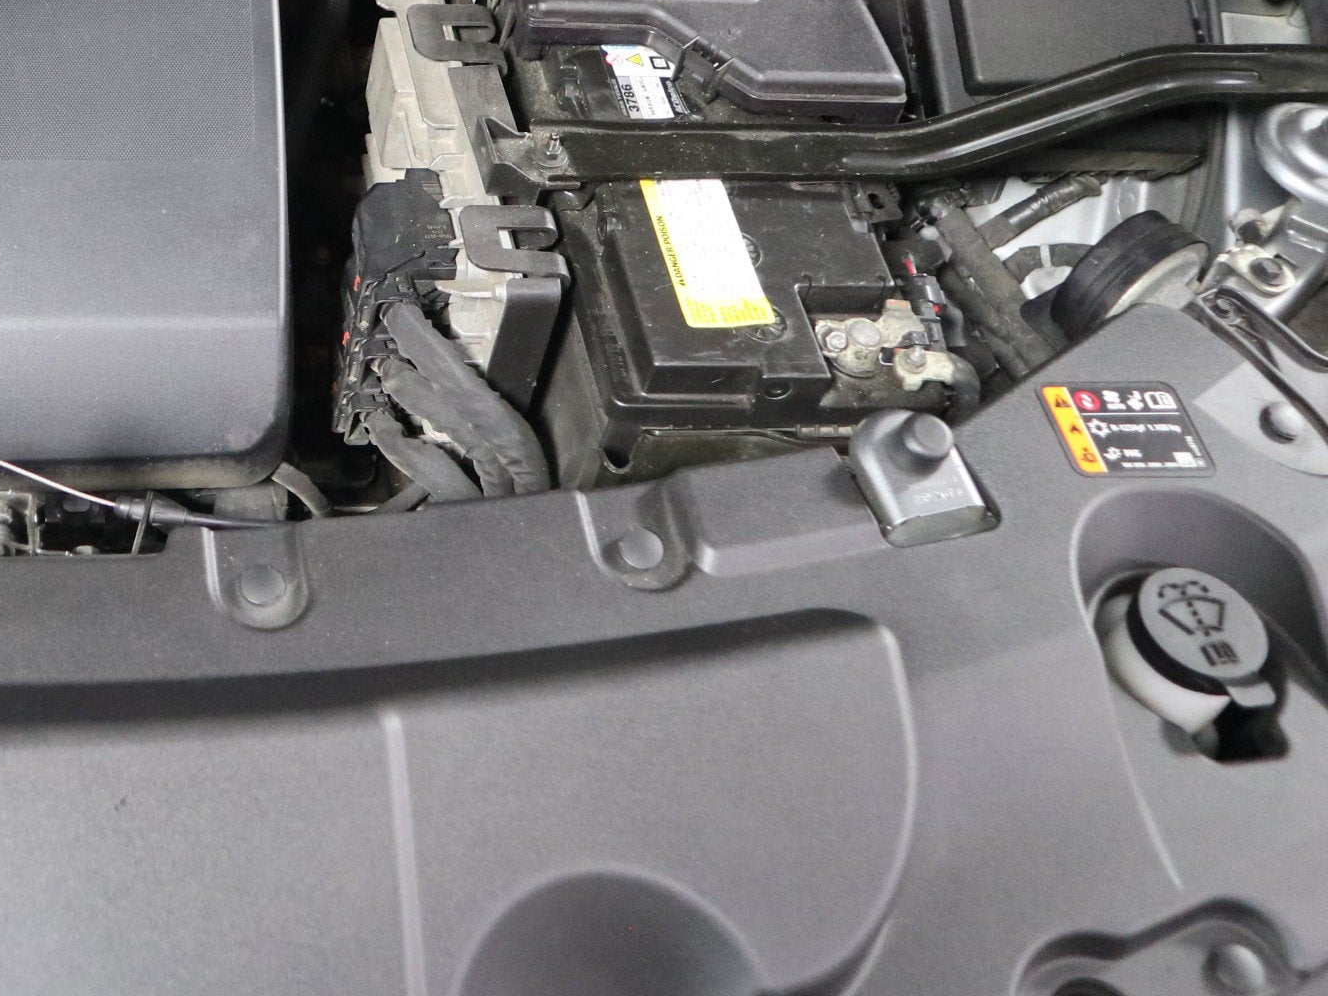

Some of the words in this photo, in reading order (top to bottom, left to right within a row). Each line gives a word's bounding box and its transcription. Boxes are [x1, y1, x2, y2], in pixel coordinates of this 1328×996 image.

[621, 83, 640, 112] 3786
[656, 215, 672, 245] POISON
[666, 247, 683, 278] DANGER
